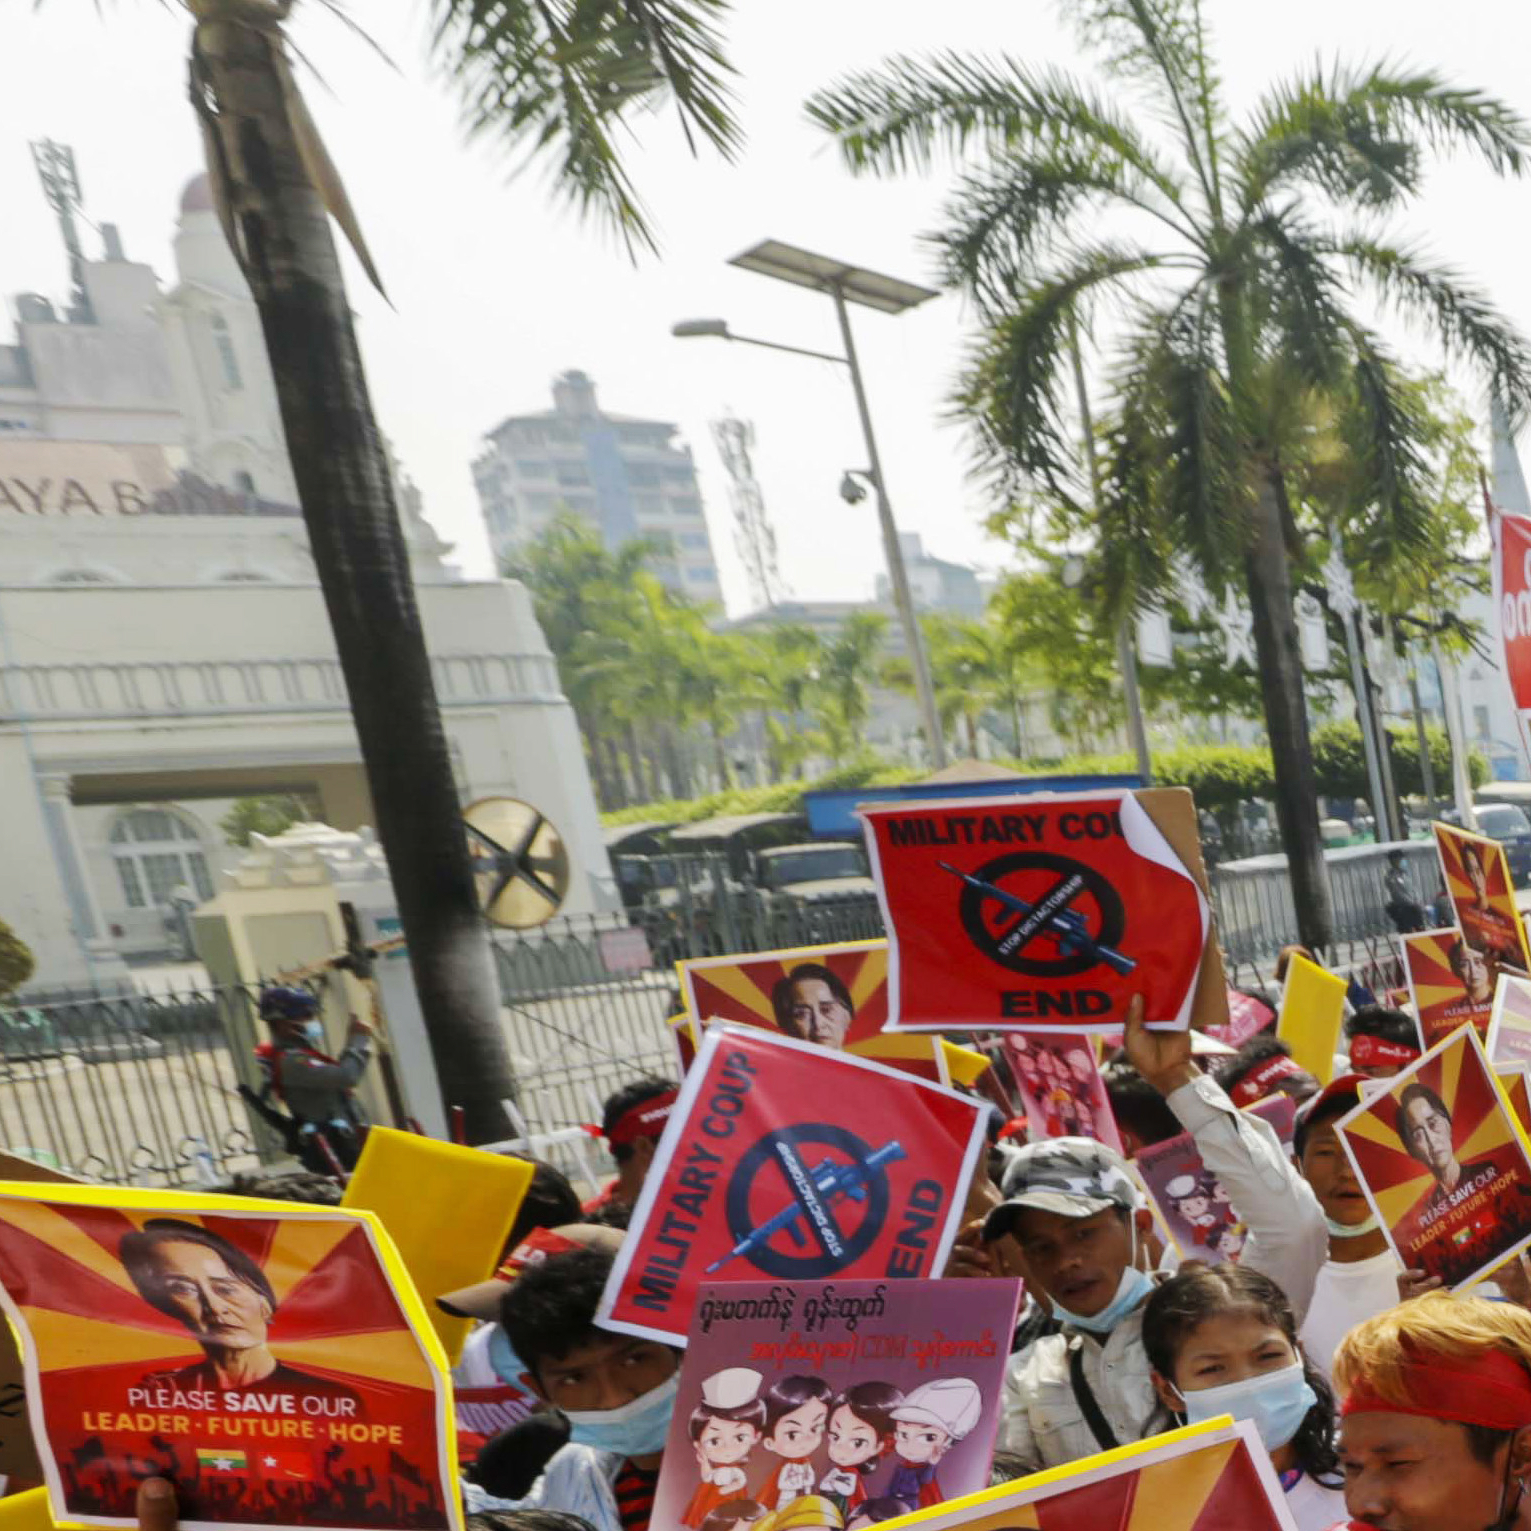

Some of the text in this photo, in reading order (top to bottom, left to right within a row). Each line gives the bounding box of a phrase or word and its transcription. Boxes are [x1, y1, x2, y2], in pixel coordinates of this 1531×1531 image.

[889, 813, 1047, 845] MILITARY
[1001, 989, 1114, 1018] END
[633, 1137, 724, 1313] MILITARY
[703, 1051, 760, 1137] COUP
[1418, 1165, 1497, 1228] PLEASE SAVE OUR
[888, 1178, 946, 1279] END
[1410, 1168, 1519, 1252] LEADER FUTURE HOPE
[128, 1387, 355, 1418] PLEASE SAVE OUR
[83, 1411, 403, 1445] LEADER FUTURE HOPE
